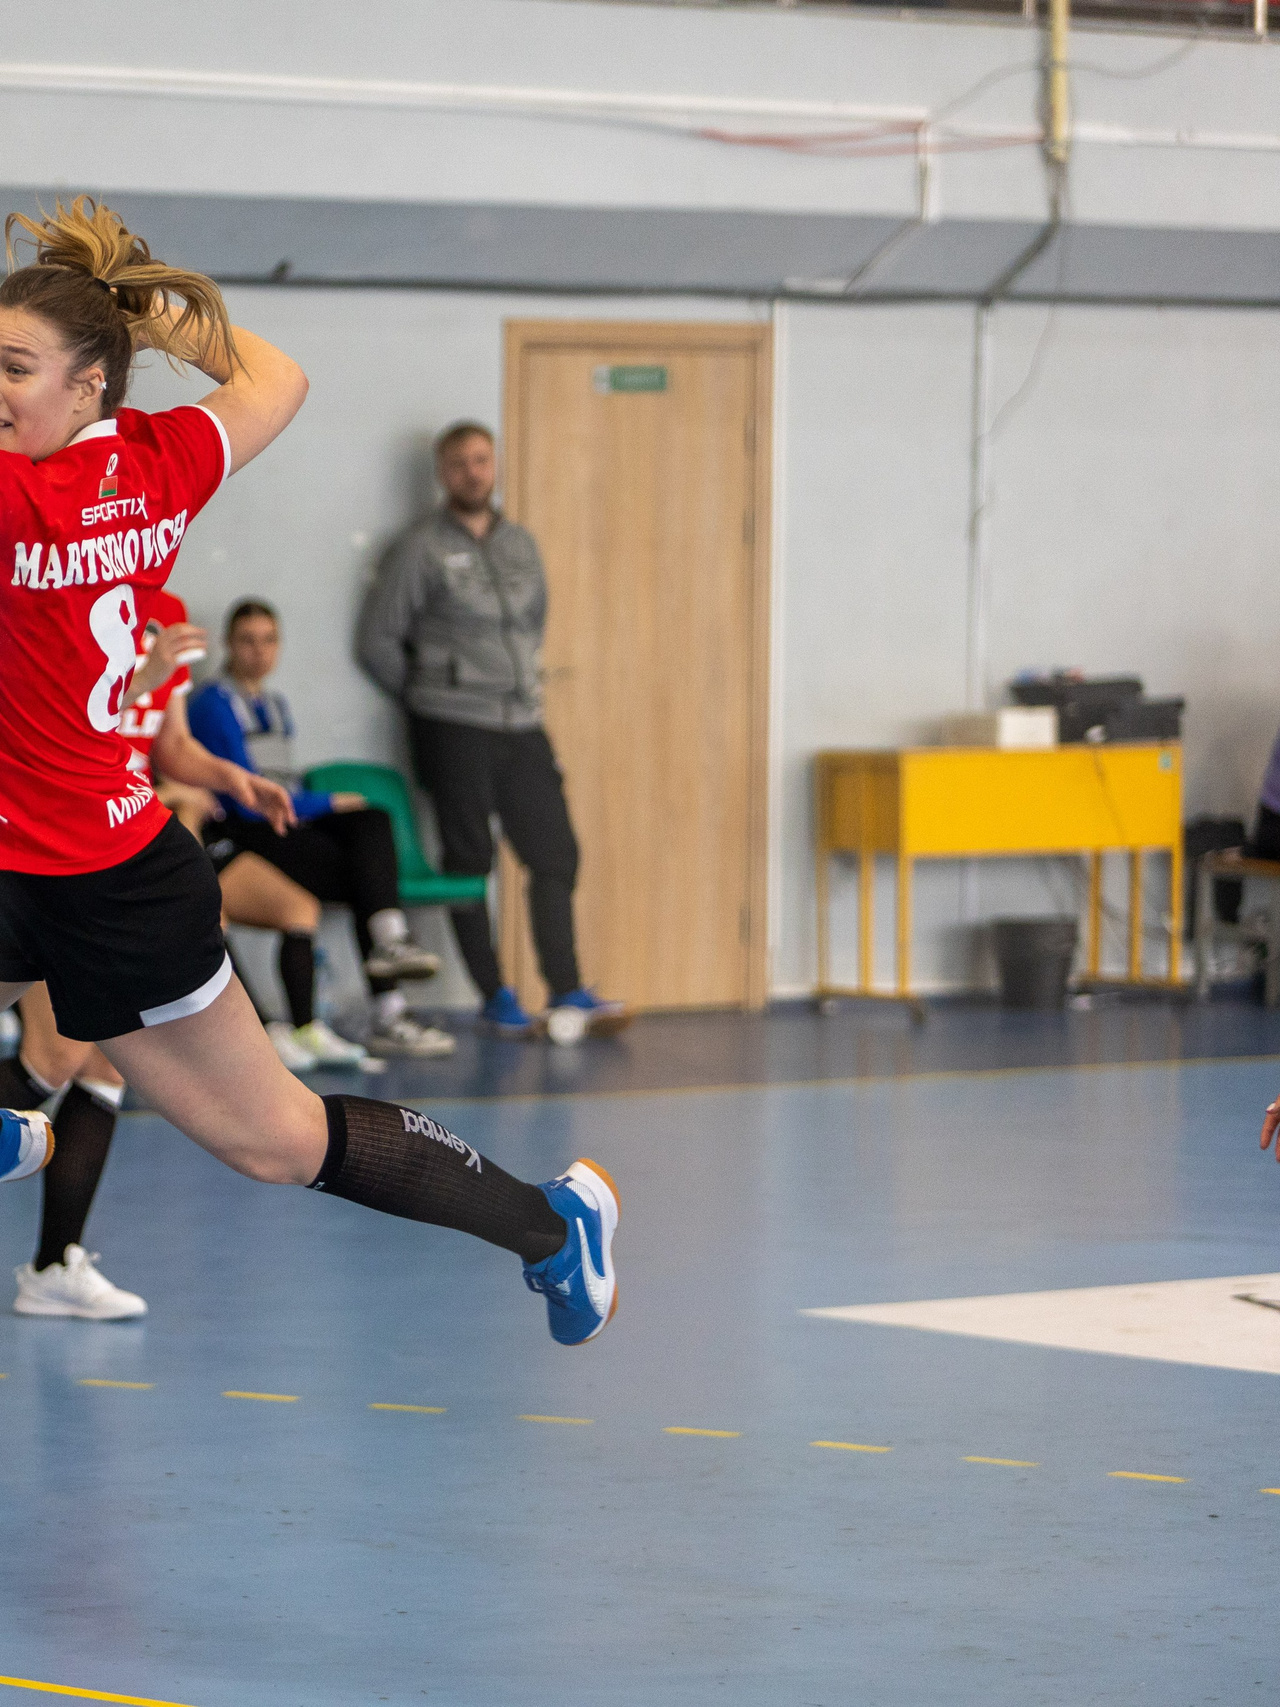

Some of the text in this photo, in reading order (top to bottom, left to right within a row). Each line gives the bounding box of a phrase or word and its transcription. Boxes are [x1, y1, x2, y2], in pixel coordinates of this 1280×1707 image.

[81, 490, 148, 526] SPORTIX
[11, 508, 188, 589] MARTSINOVICH
[87, 583, 138, 733] 8
[399, 1108, 483, 1174] Kempa
